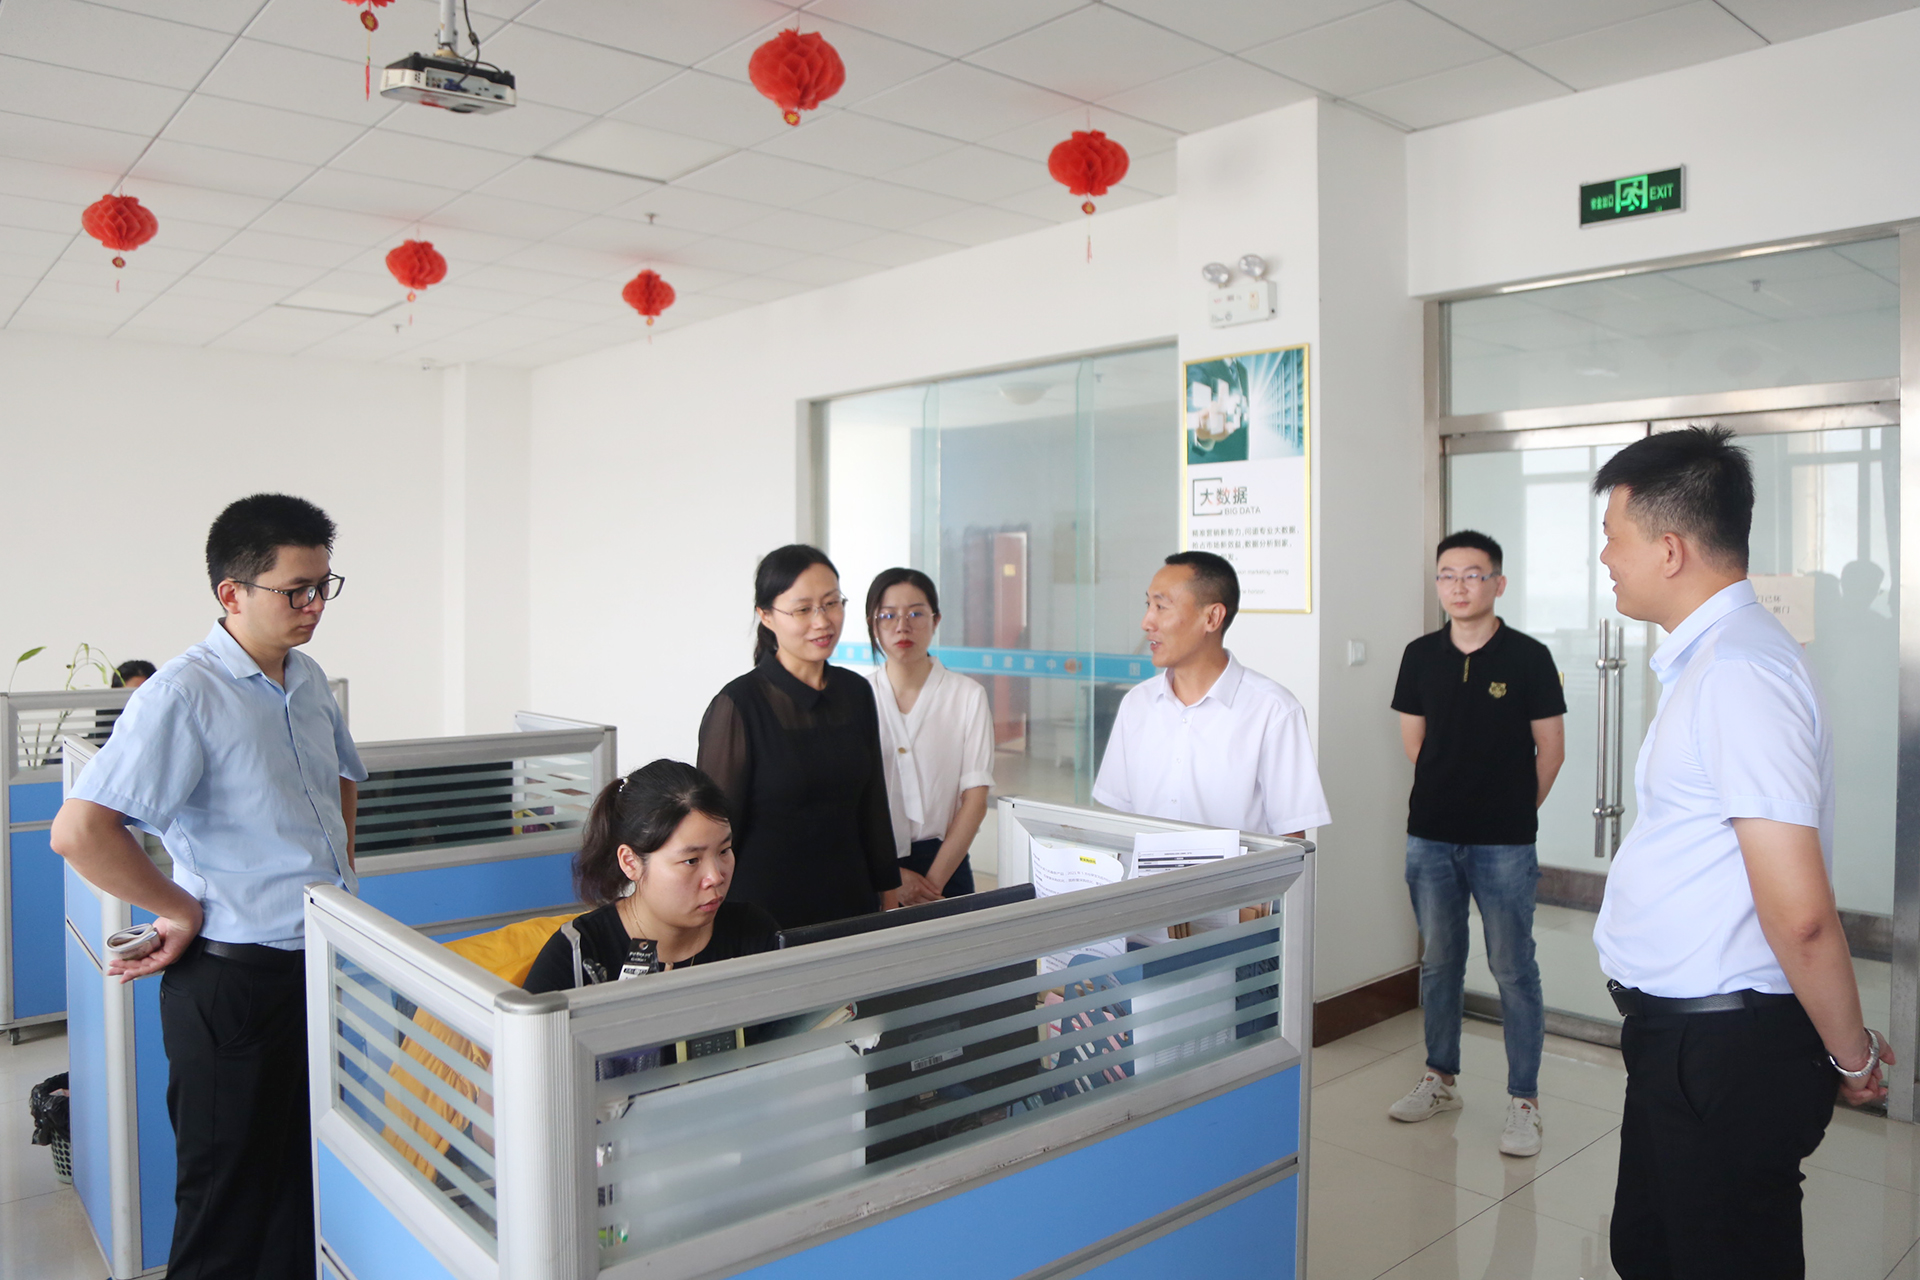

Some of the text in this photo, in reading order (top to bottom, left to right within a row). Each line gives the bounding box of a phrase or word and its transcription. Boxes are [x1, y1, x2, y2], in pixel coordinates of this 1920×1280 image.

[1650, 183, 1674, 200] EXIT
[1200, 486, 1247, 506] 大数据
[1224, 505, 1261, 516] BIG DATA
